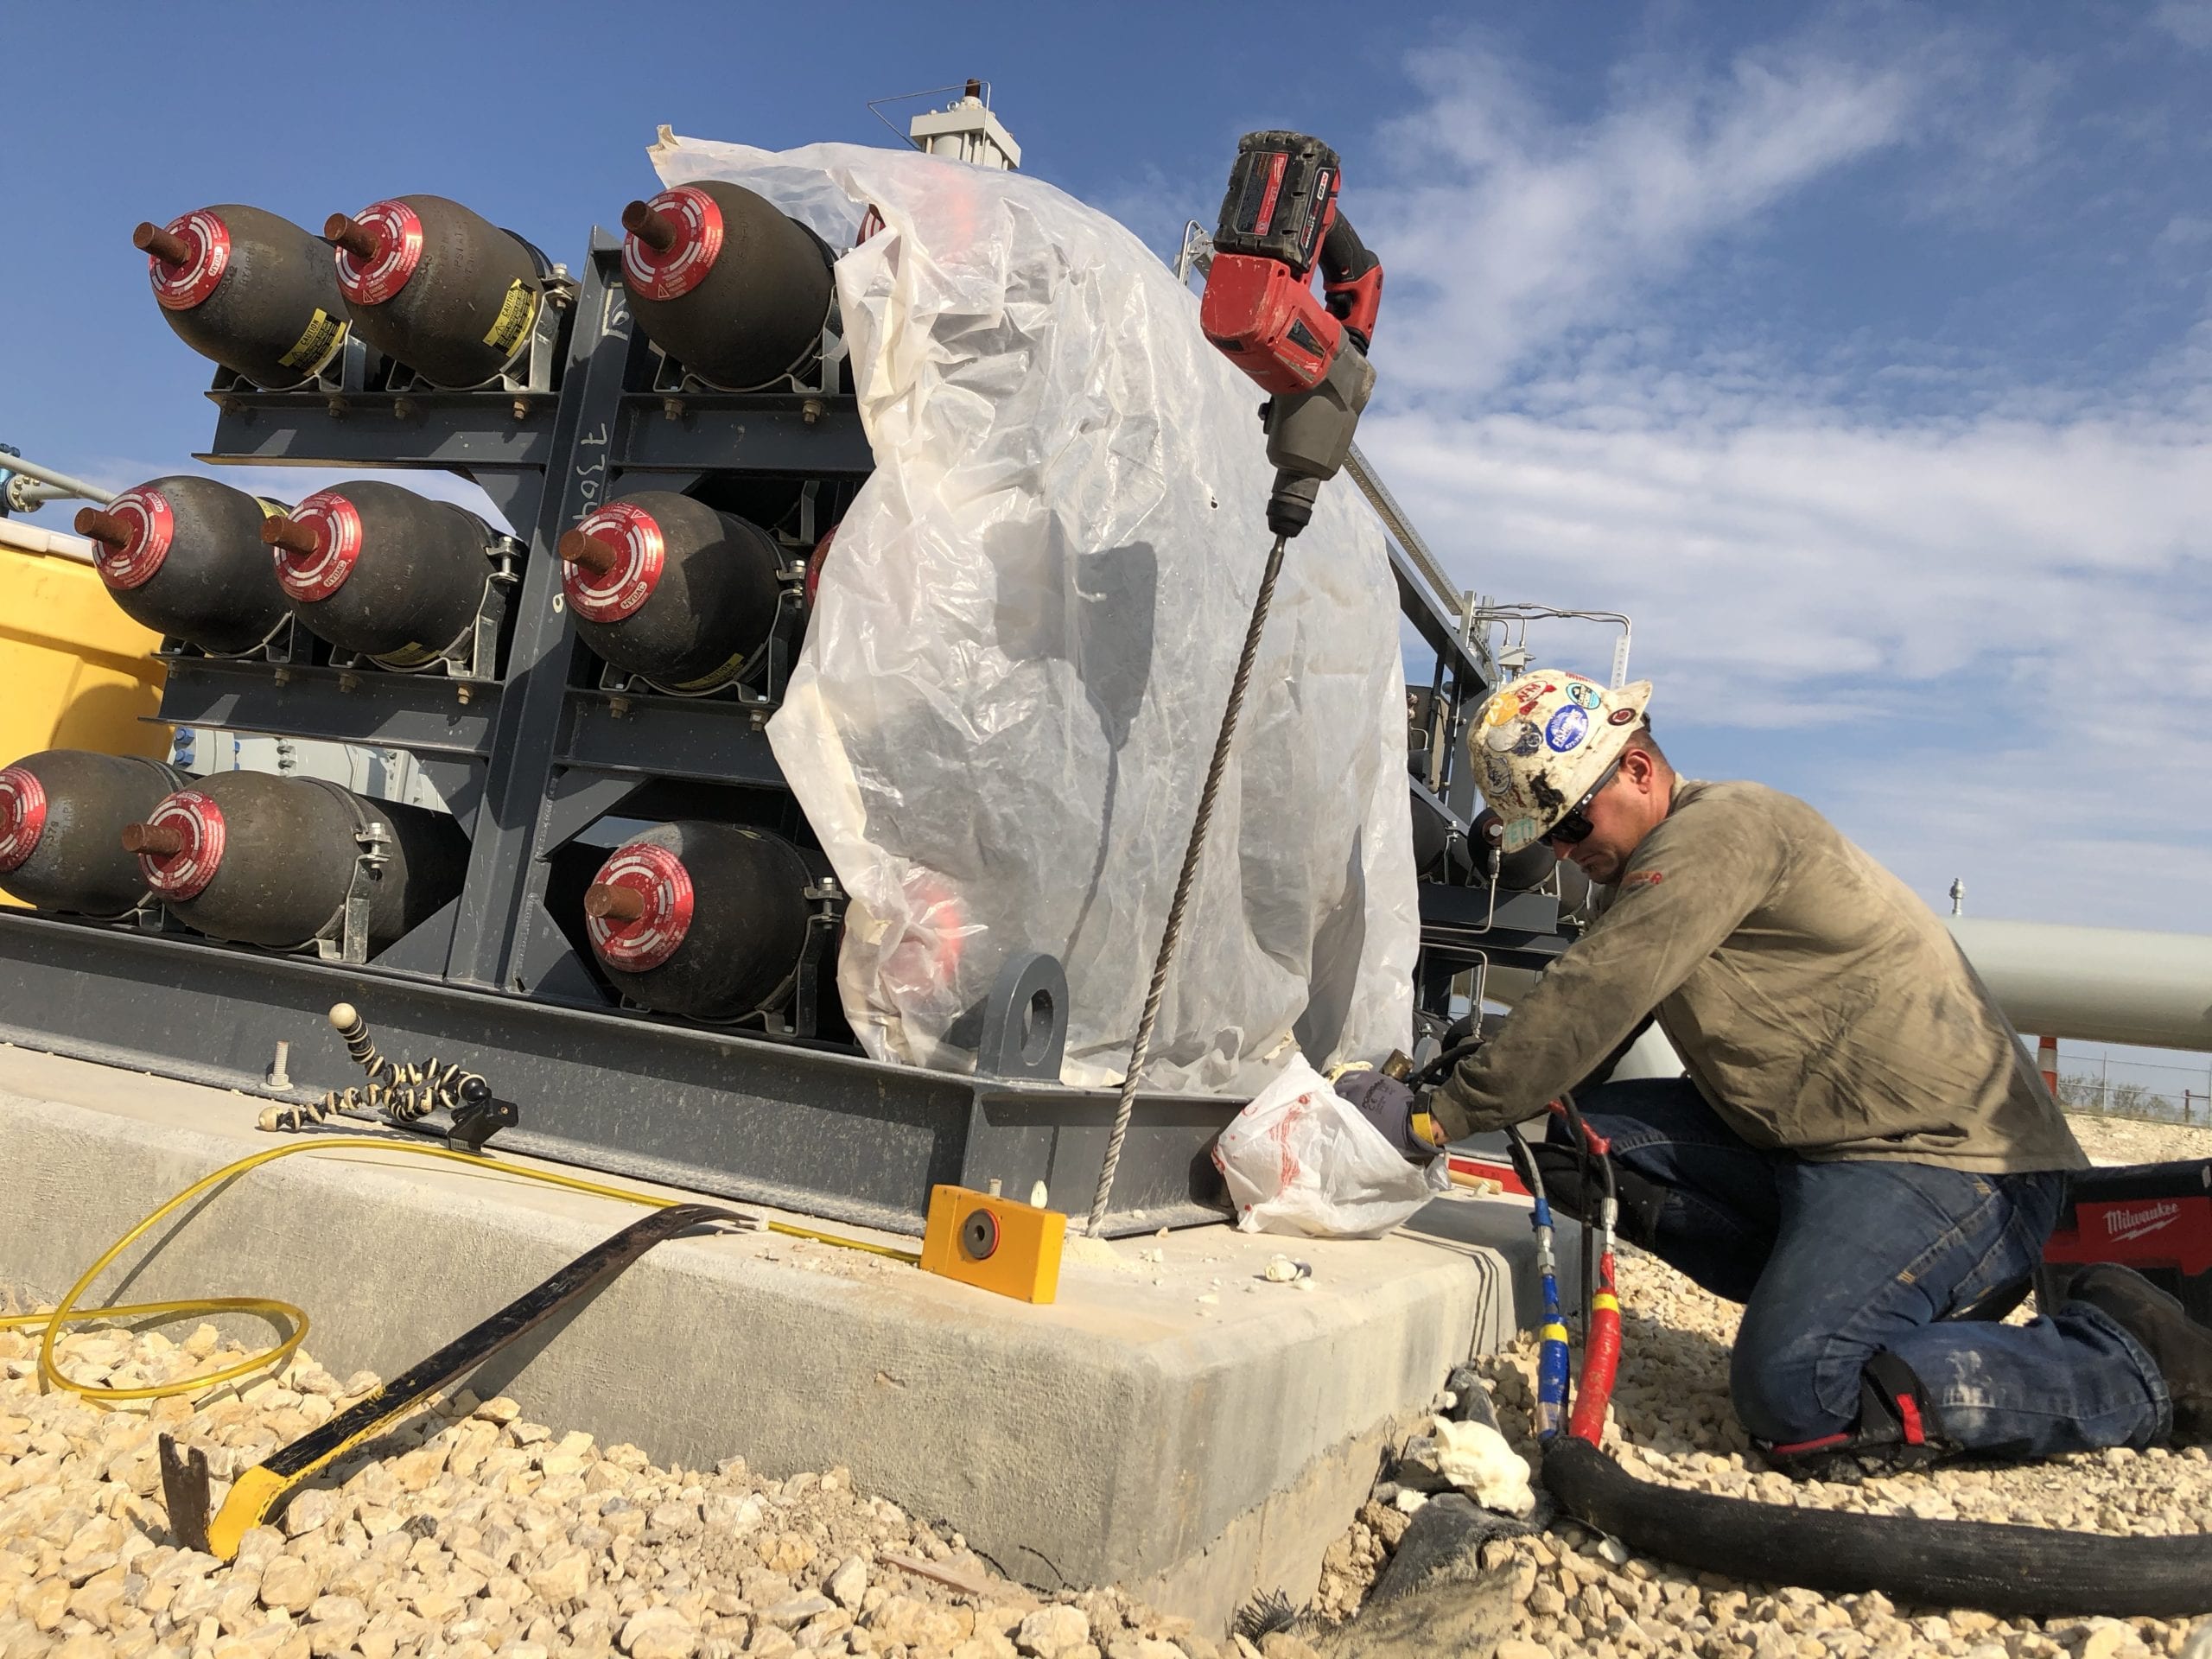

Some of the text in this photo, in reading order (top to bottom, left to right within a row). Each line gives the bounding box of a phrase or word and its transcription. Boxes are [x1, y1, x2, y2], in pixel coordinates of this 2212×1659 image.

[209, 247, 223, 275] HYDA
[300, 319, 320, 346] CAUTION
[148, 493, 162, 512] HYDAC
[324, 562, 346, 587] HYDAC
[622, 583, 646, 608] HYDAC
[2101, 1202, 2180, 1235] Milwaukee
